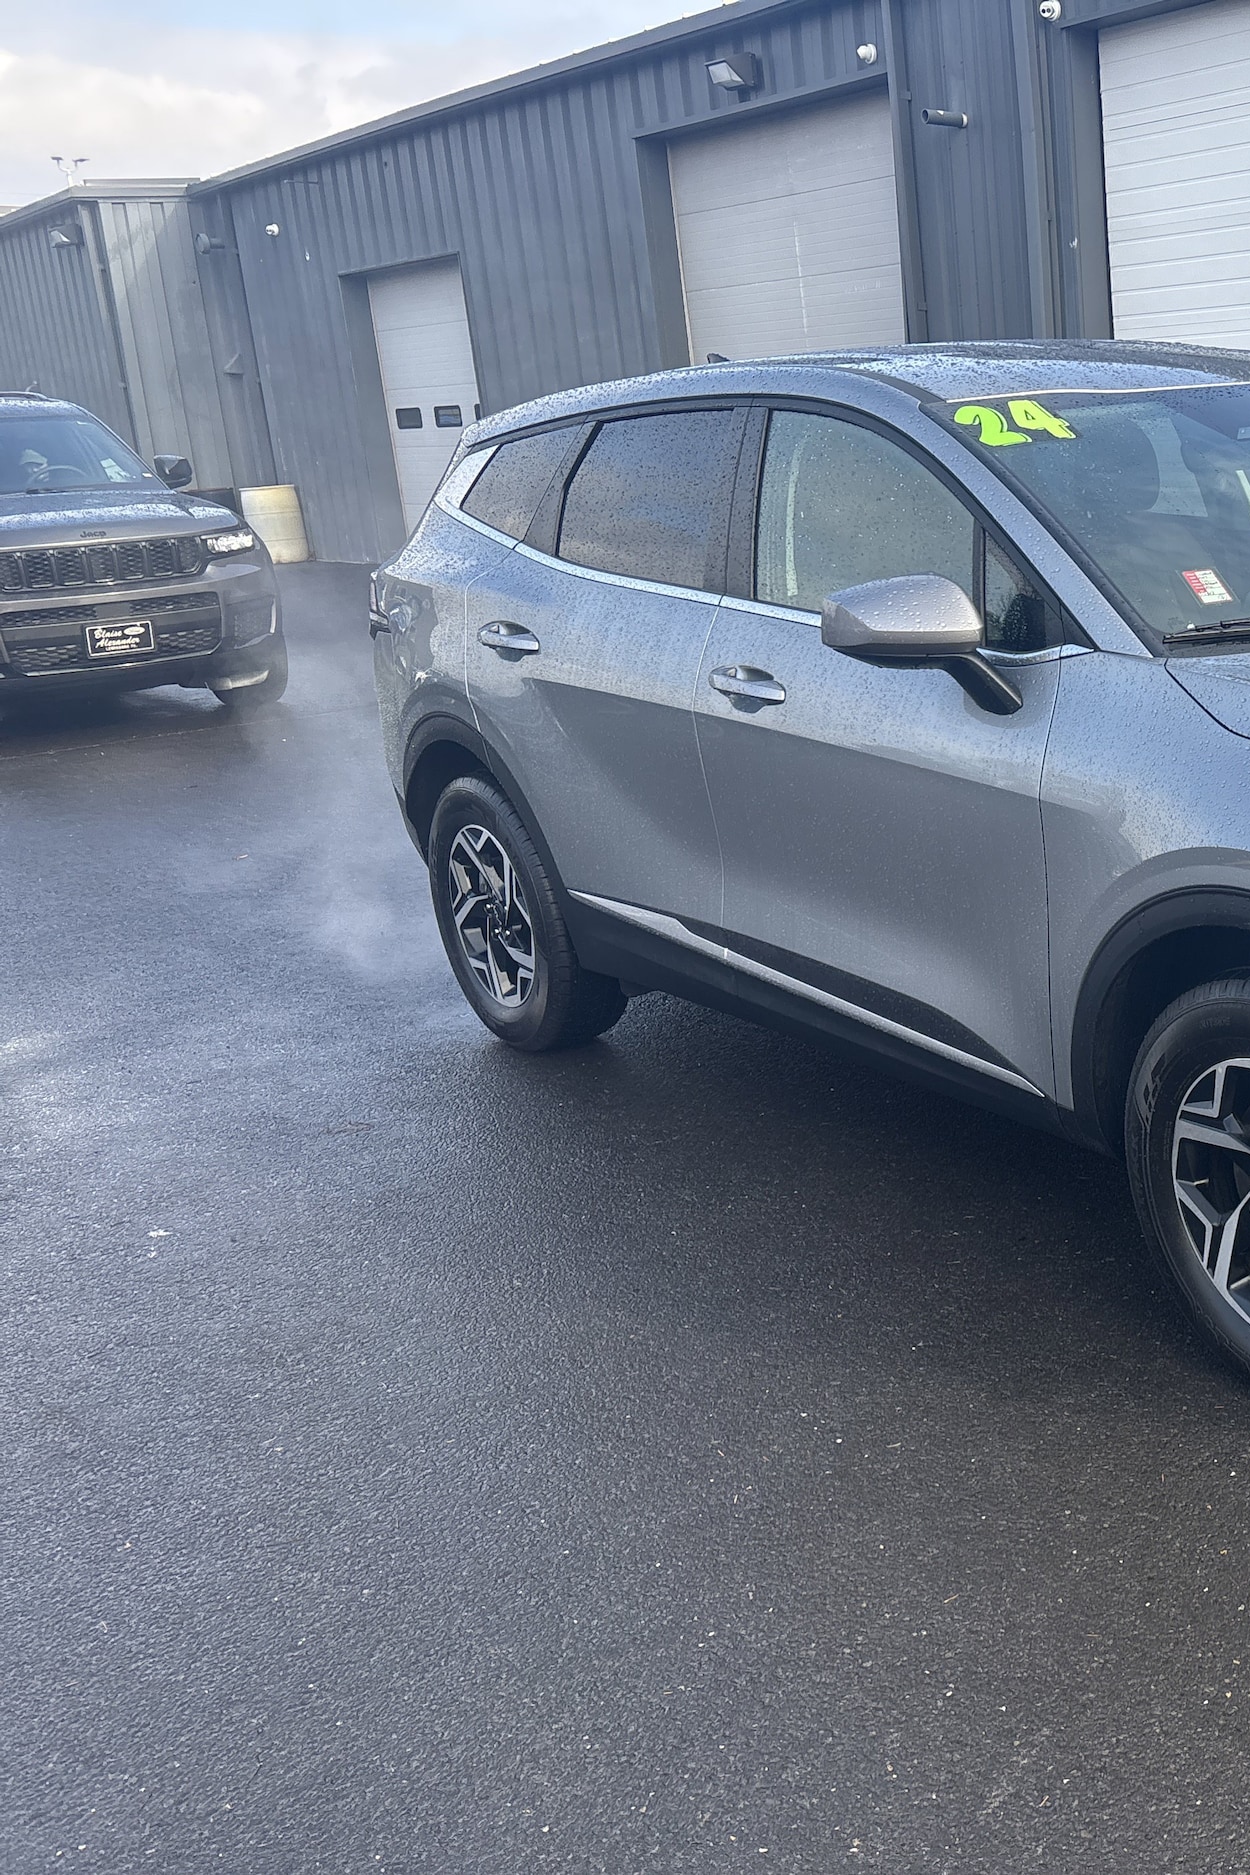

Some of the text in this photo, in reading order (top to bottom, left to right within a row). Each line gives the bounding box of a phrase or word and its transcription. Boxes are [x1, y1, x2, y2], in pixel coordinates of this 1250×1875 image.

[953, 399, 1077, 447] 24
[94, 629, 122, 639] Blaise
[95, 636, 140, 649] Alexander
